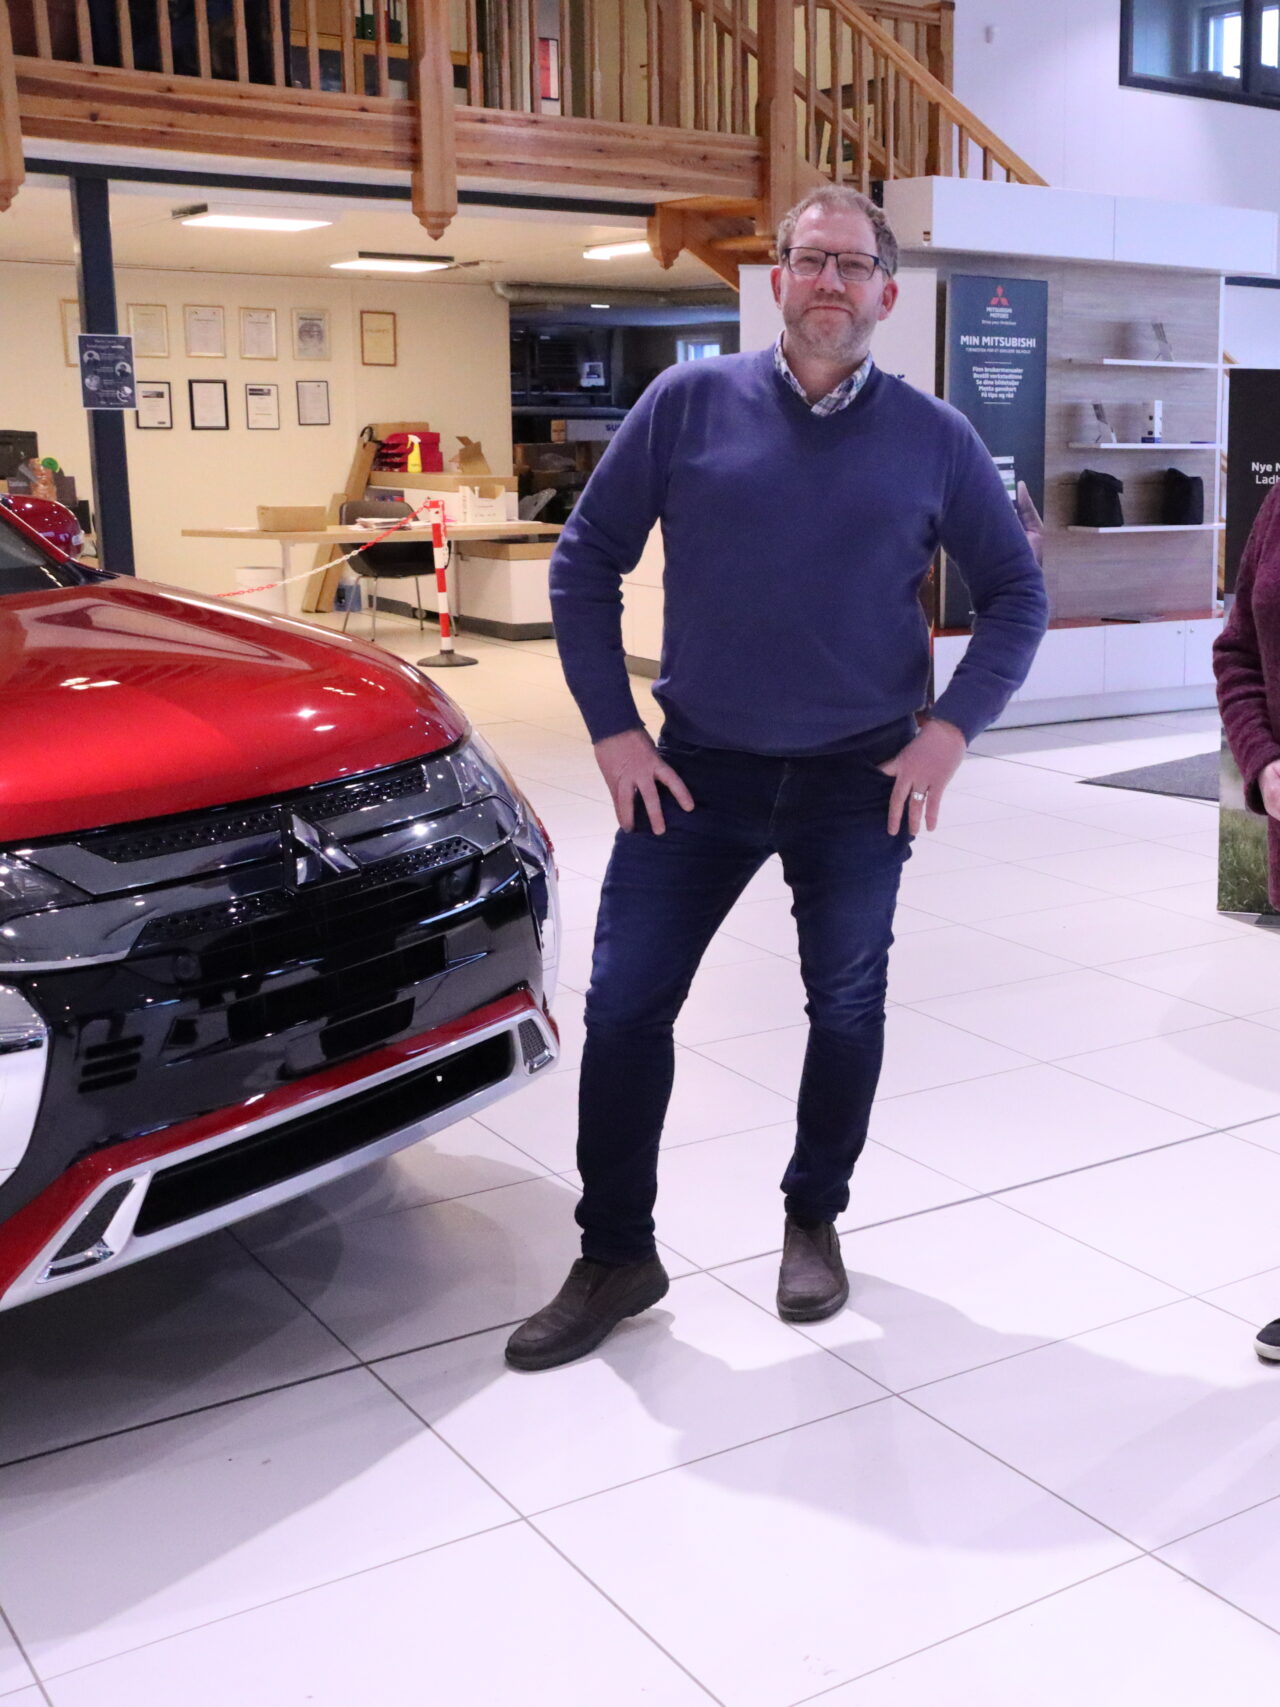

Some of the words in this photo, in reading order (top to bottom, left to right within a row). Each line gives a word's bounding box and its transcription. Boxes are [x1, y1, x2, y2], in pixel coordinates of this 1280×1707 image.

[960, 335, 980, 346] MIN
[981, 336, 1037, 348] MITSUBISHI
[1251, 462, 1273, 474] Nye
